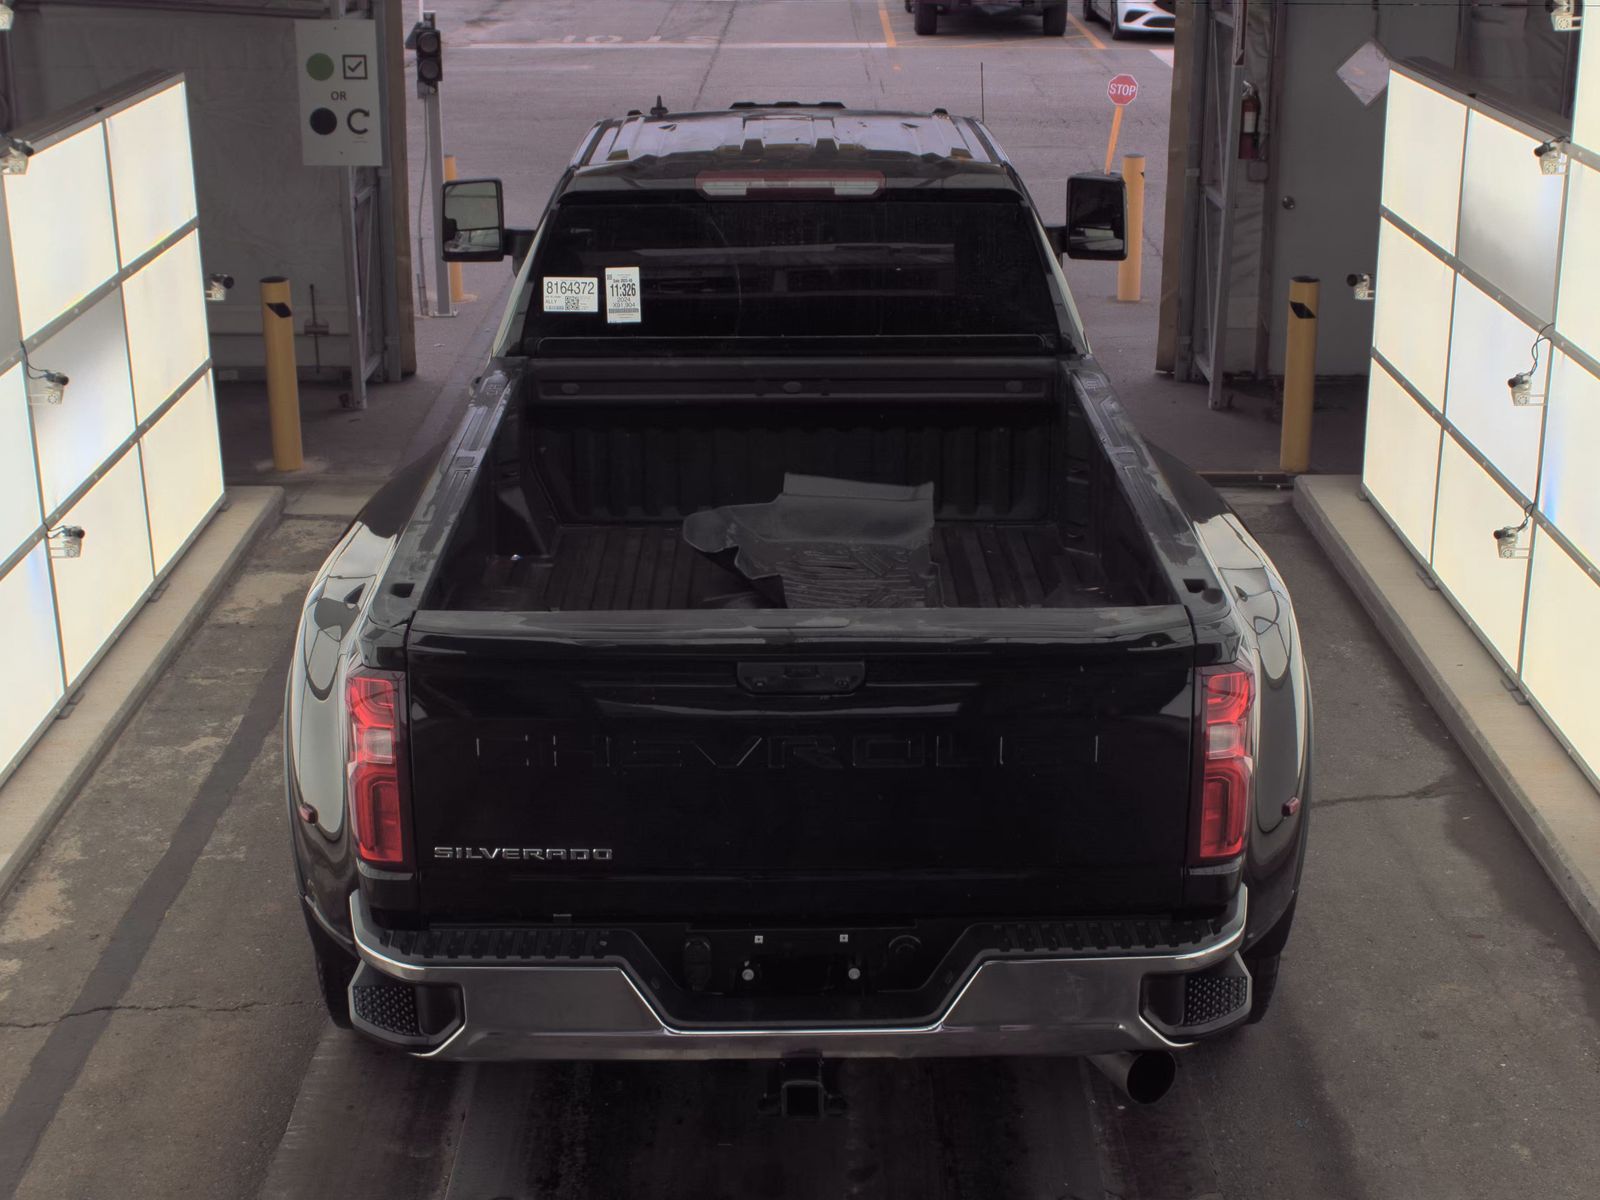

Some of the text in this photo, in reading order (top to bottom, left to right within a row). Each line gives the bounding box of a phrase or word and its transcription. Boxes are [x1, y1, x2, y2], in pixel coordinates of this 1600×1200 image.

[330, 91, 347, 101] OR
[1109, 83, 1136, 96] STOP
[546, 281, 595, 295] 8164372
[610, 283, 636, 297] 11:326
[469, 734, 1134, 769] CHEVROL
[434, 846, 613, 860] SILVERADO
